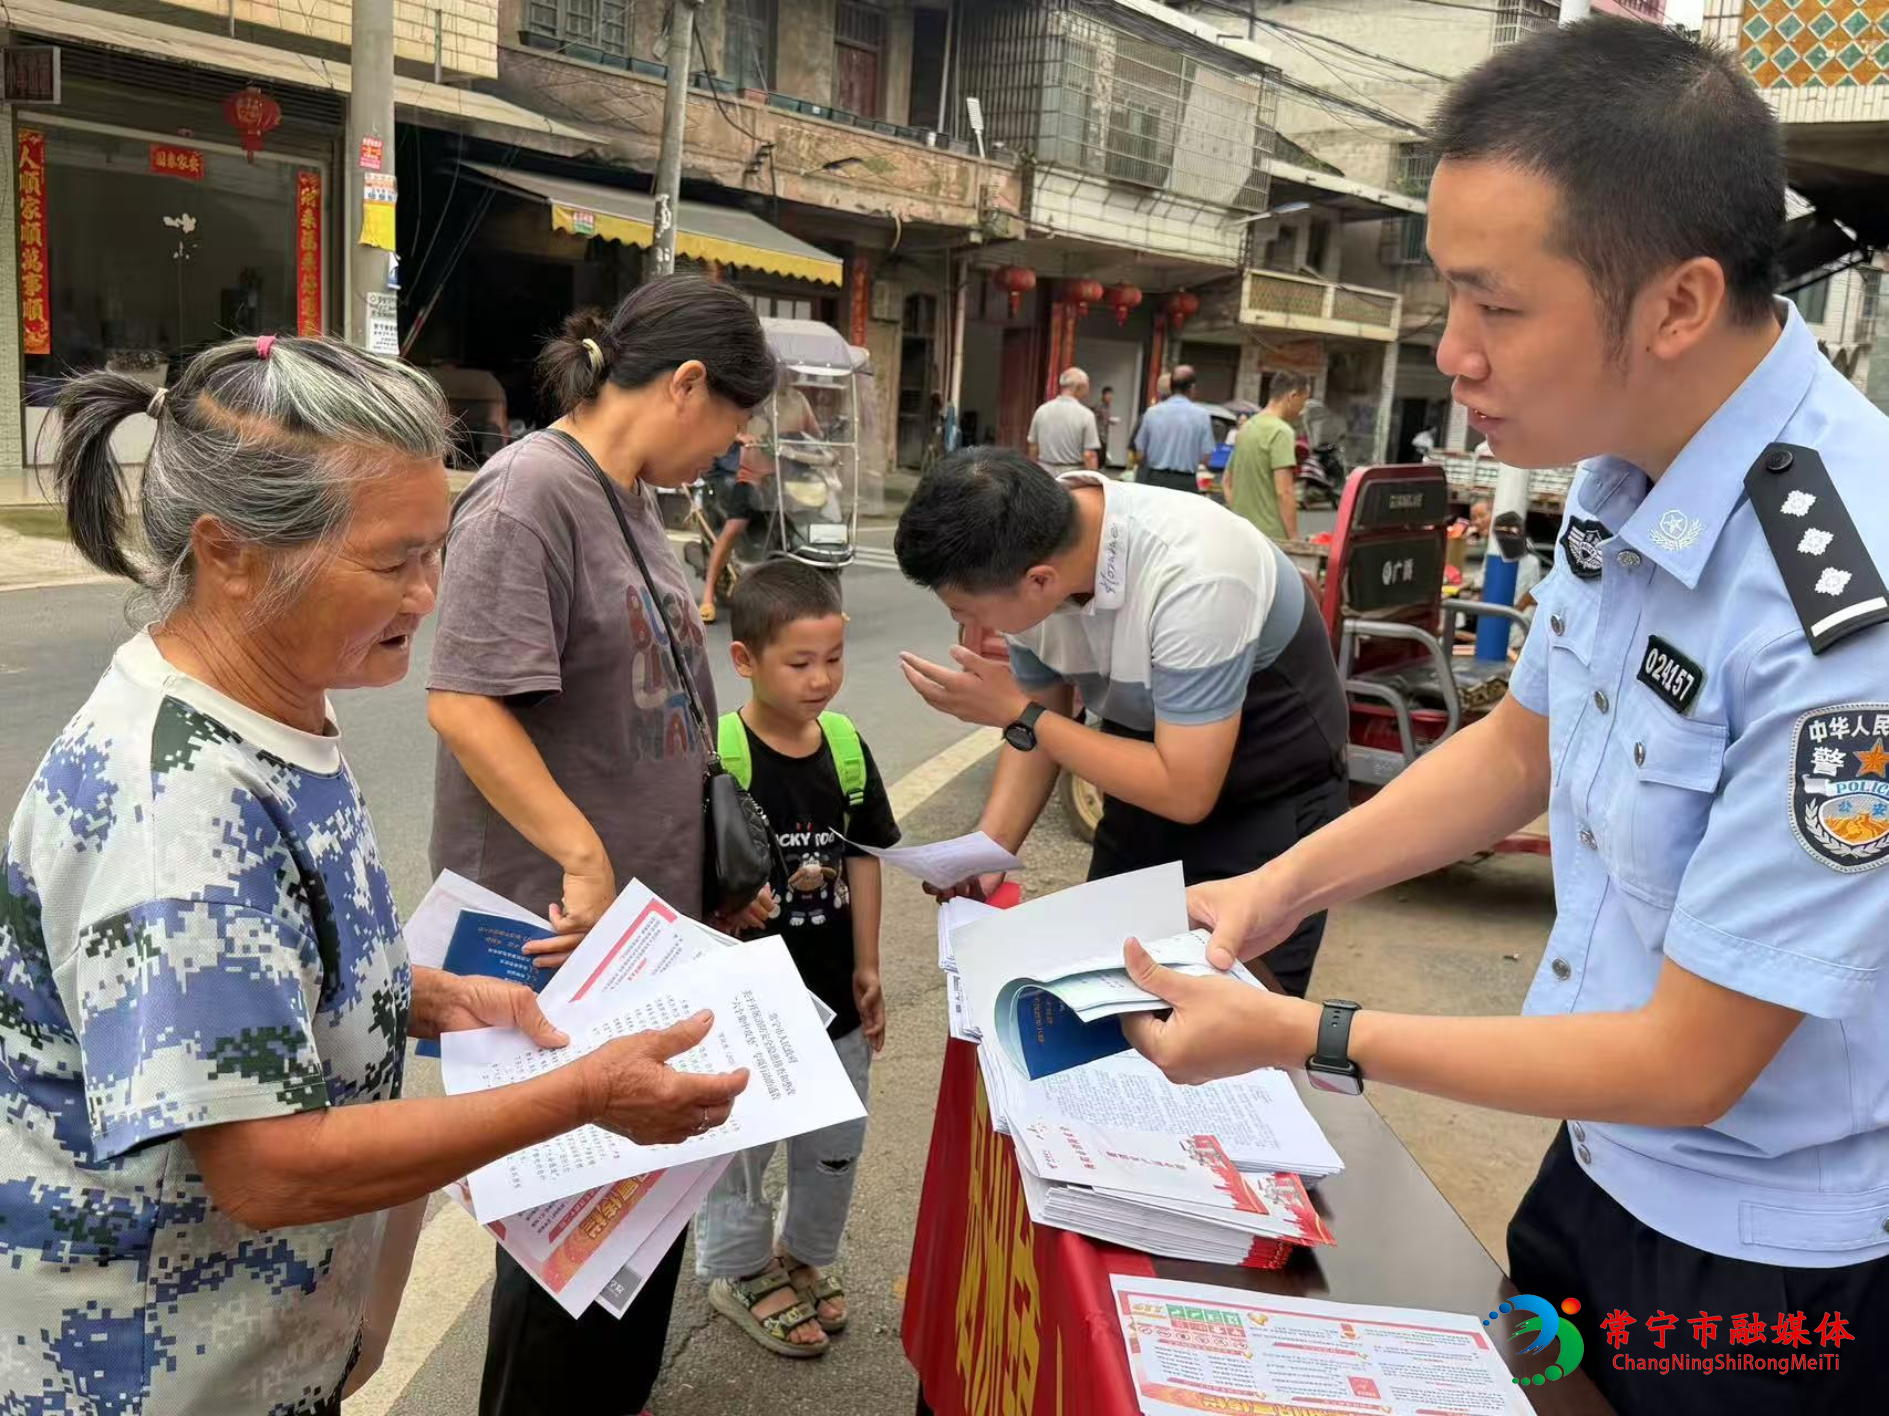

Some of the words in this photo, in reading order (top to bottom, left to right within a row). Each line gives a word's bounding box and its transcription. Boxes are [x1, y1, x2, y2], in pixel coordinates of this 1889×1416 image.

[1645, 647, 1695, 701] 024157
[1810, 746, 1847, 777] 警
[1836, 780, 1889, 796] POLIC
[775, 832, 811, 847] CKY
